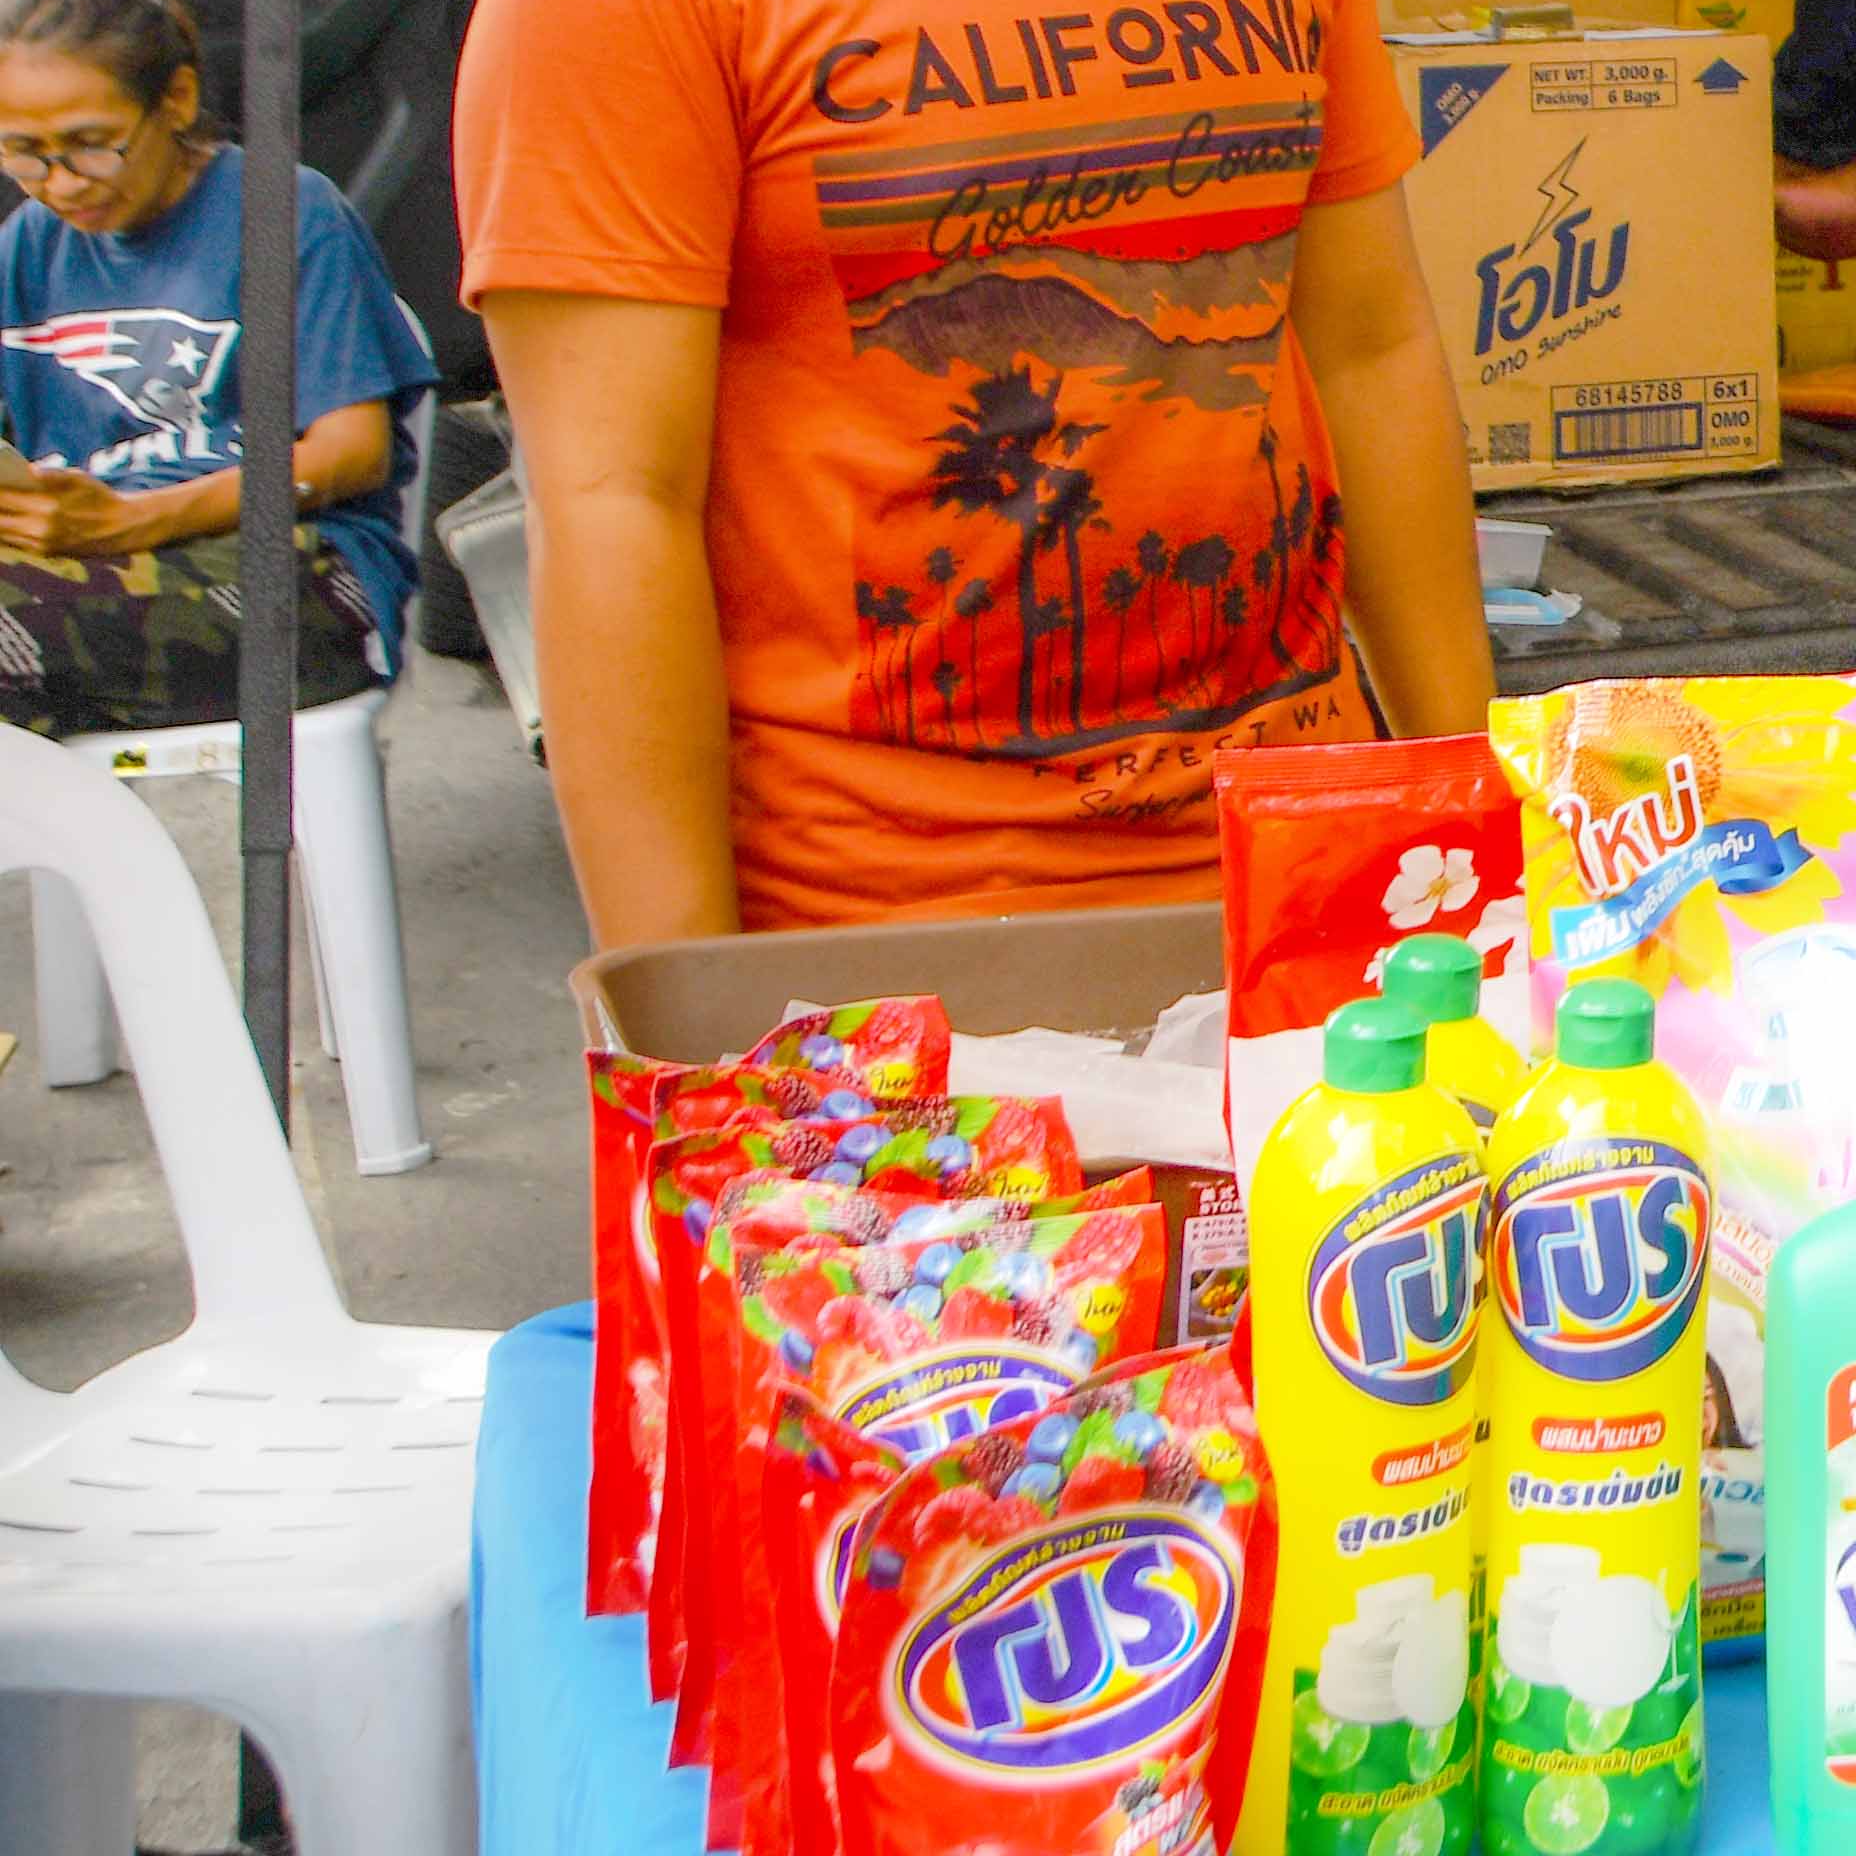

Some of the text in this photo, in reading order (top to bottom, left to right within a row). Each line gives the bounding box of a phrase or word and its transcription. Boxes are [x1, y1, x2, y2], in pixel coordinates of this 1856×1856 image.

[1534, 69, 1561, 83] NET
[1604, 66, 1650, 82] 3,000
[1536, 89, 1661, 107] Packing 6 Bags
[928, 92, 1323, 265] Golden Coast
[1475, 207, 1630, 356] โอโม
[1575, 379, 1750, 408] 68145788 6x1
[1711, 410, 1750, 429] OMO
[1548, 754, 1702, 897] ใหม่
[1508, 1468, 1682, 1510] สูตรเข้มข้น
